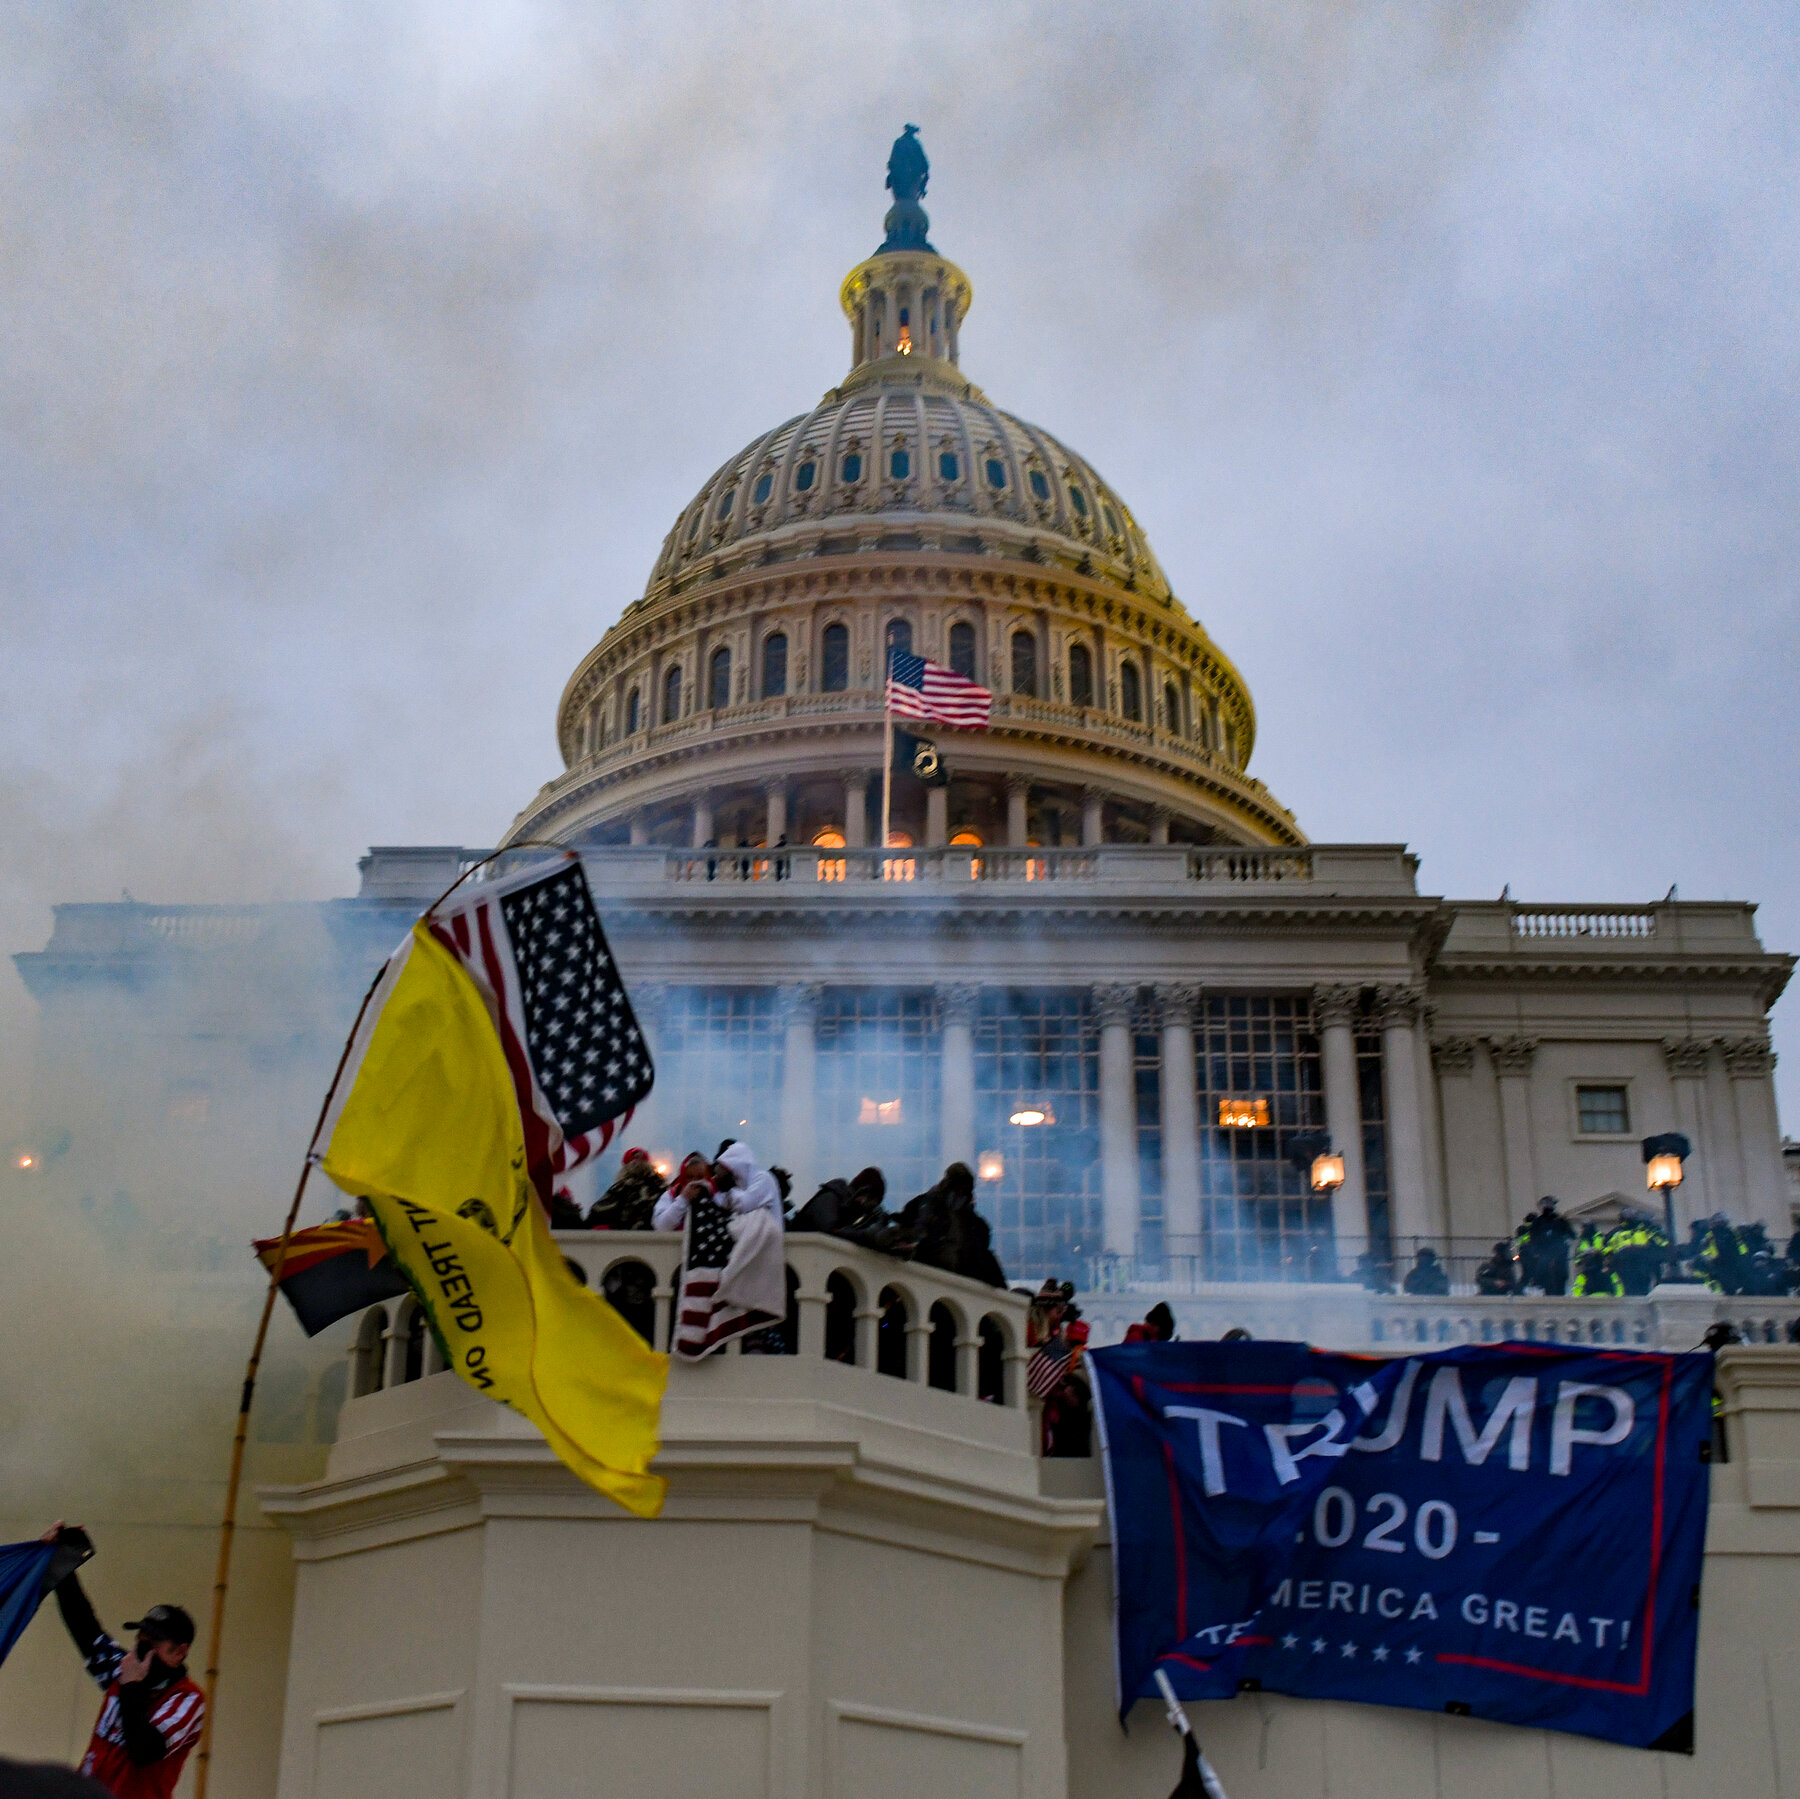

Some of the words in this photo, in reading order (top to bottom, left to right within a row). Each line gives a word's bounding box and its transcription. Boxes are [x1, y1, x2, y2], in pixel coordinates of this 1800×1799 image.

[1163, 1358, 1637, 1498] TRUMP
[1270, 1578, 1439, 1622] MERICA
[1461, 1592, 1632, 1651] GREAT!
